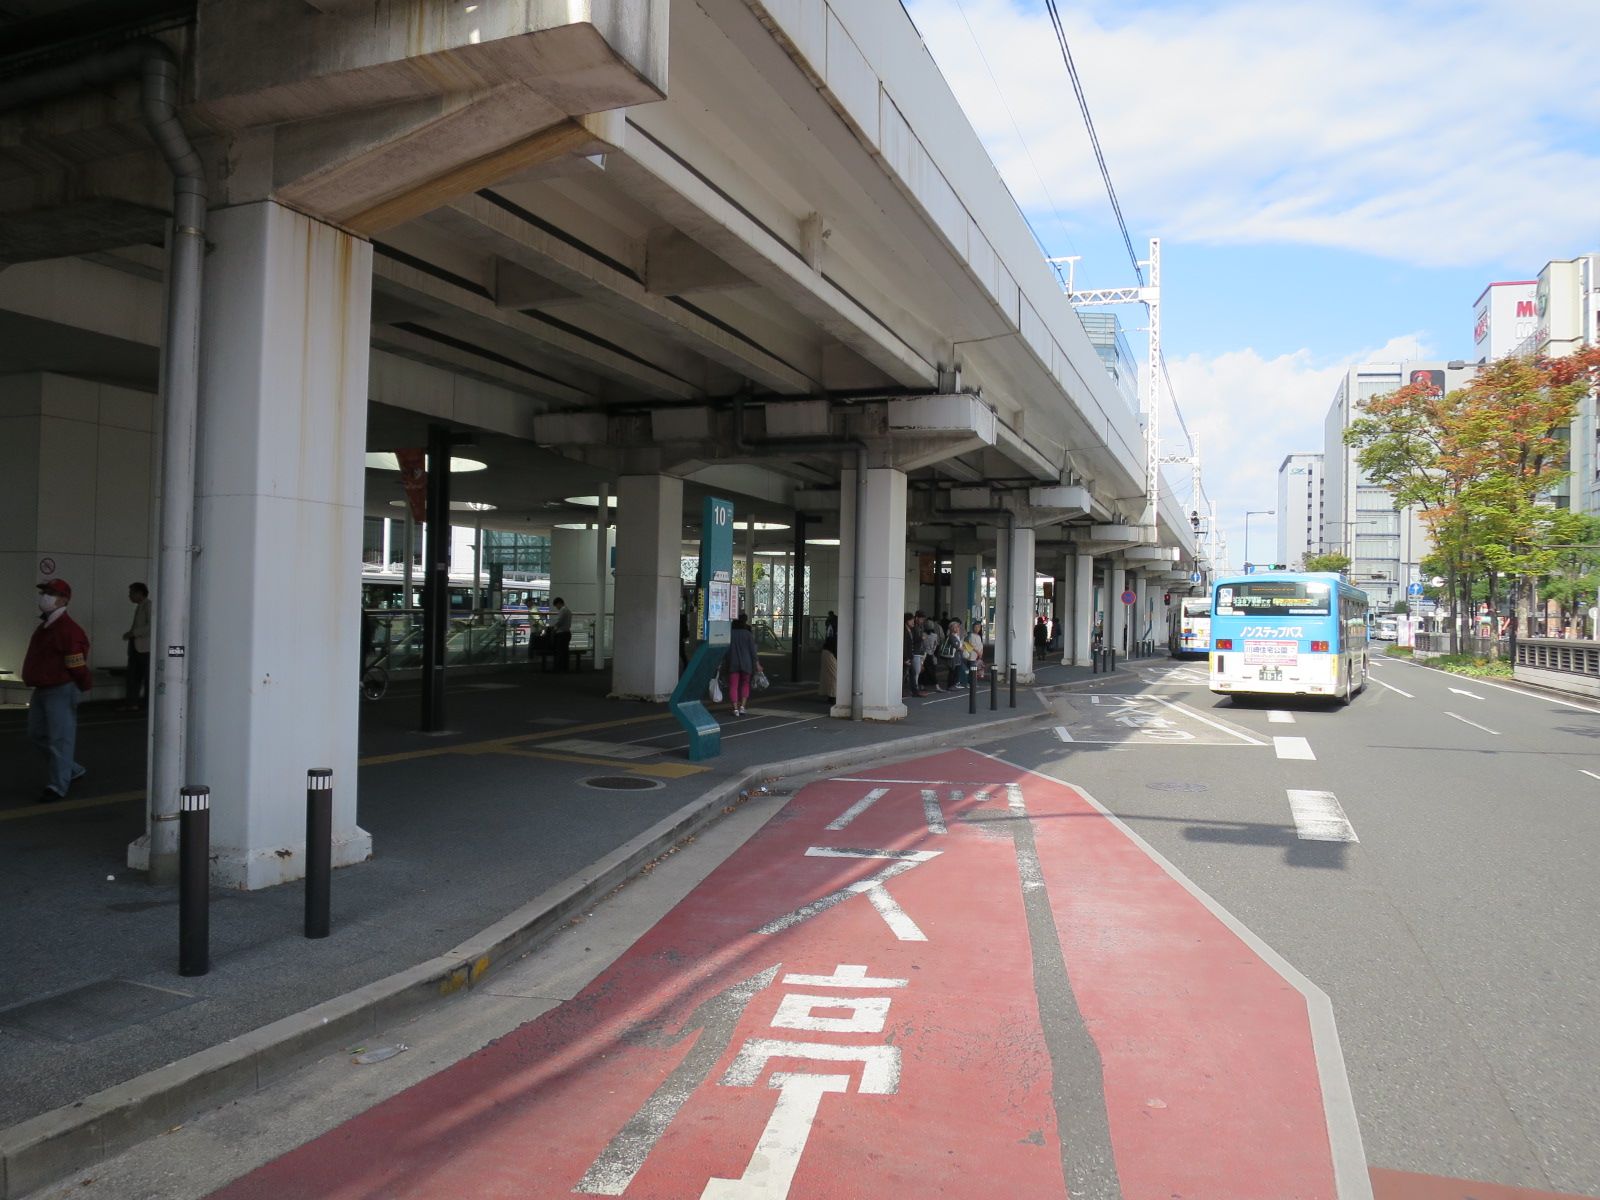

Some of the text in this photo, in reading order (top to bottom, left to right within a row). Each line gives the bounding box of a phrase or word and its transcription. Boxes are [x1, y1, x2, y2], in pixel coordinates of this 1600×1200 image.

[714, 505, 726, 527] 10
[1239, 626, 1304, 638] ノンステップバス
